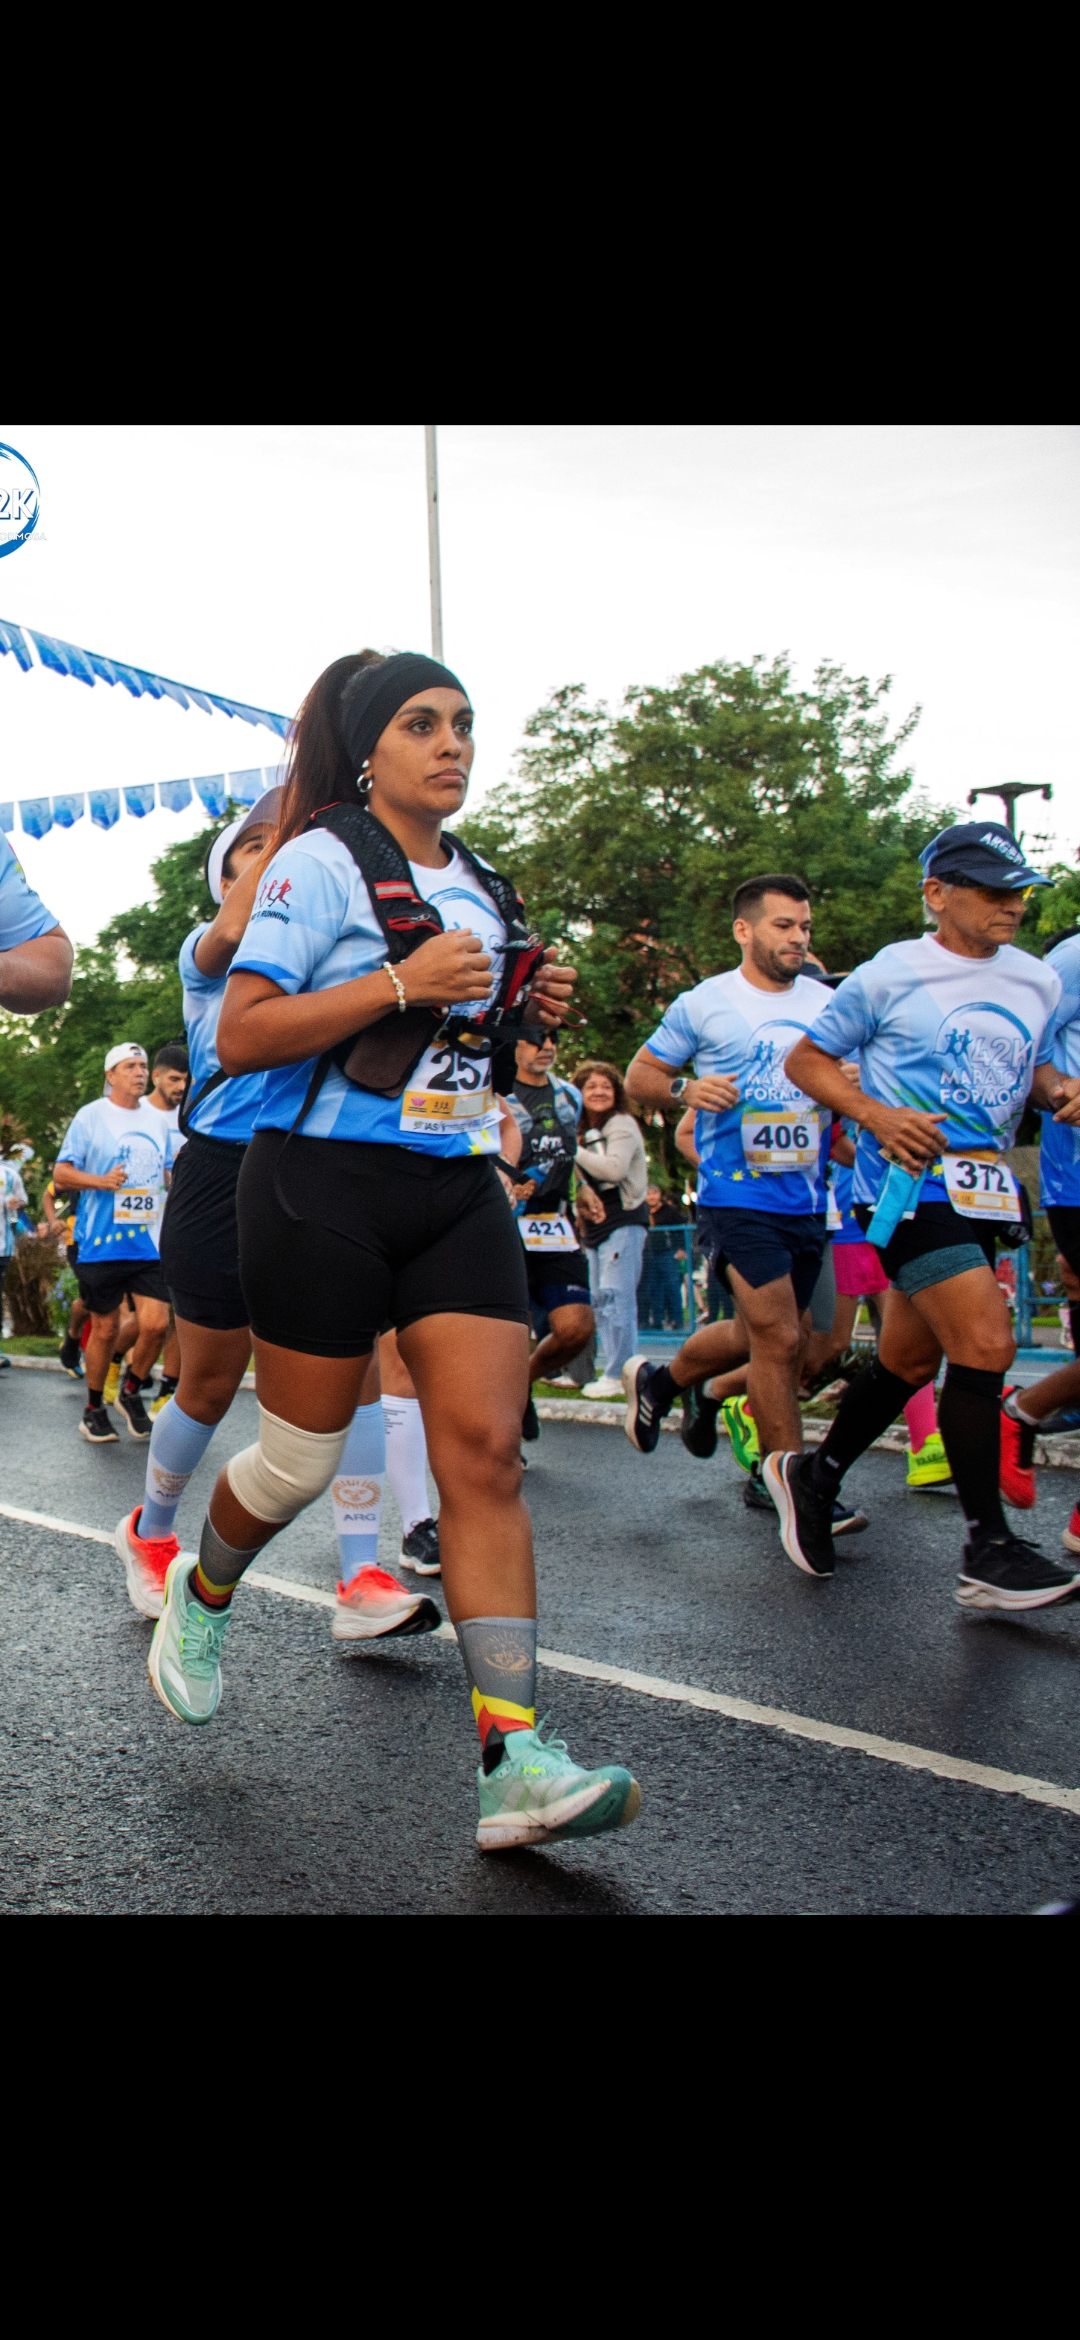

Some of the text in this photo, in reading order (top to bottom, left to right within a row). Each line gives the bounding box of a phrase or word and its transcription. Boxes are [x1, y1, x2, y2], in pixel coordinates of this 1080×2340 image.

[753, 1125, 811, 1149] 406
[955, 1160, 1010, 1194] 372
[121, 1196, 154, 1211] 428
[528, 1222, 567, 1237] 421
[343, 1513, 377, 1521] ARG
